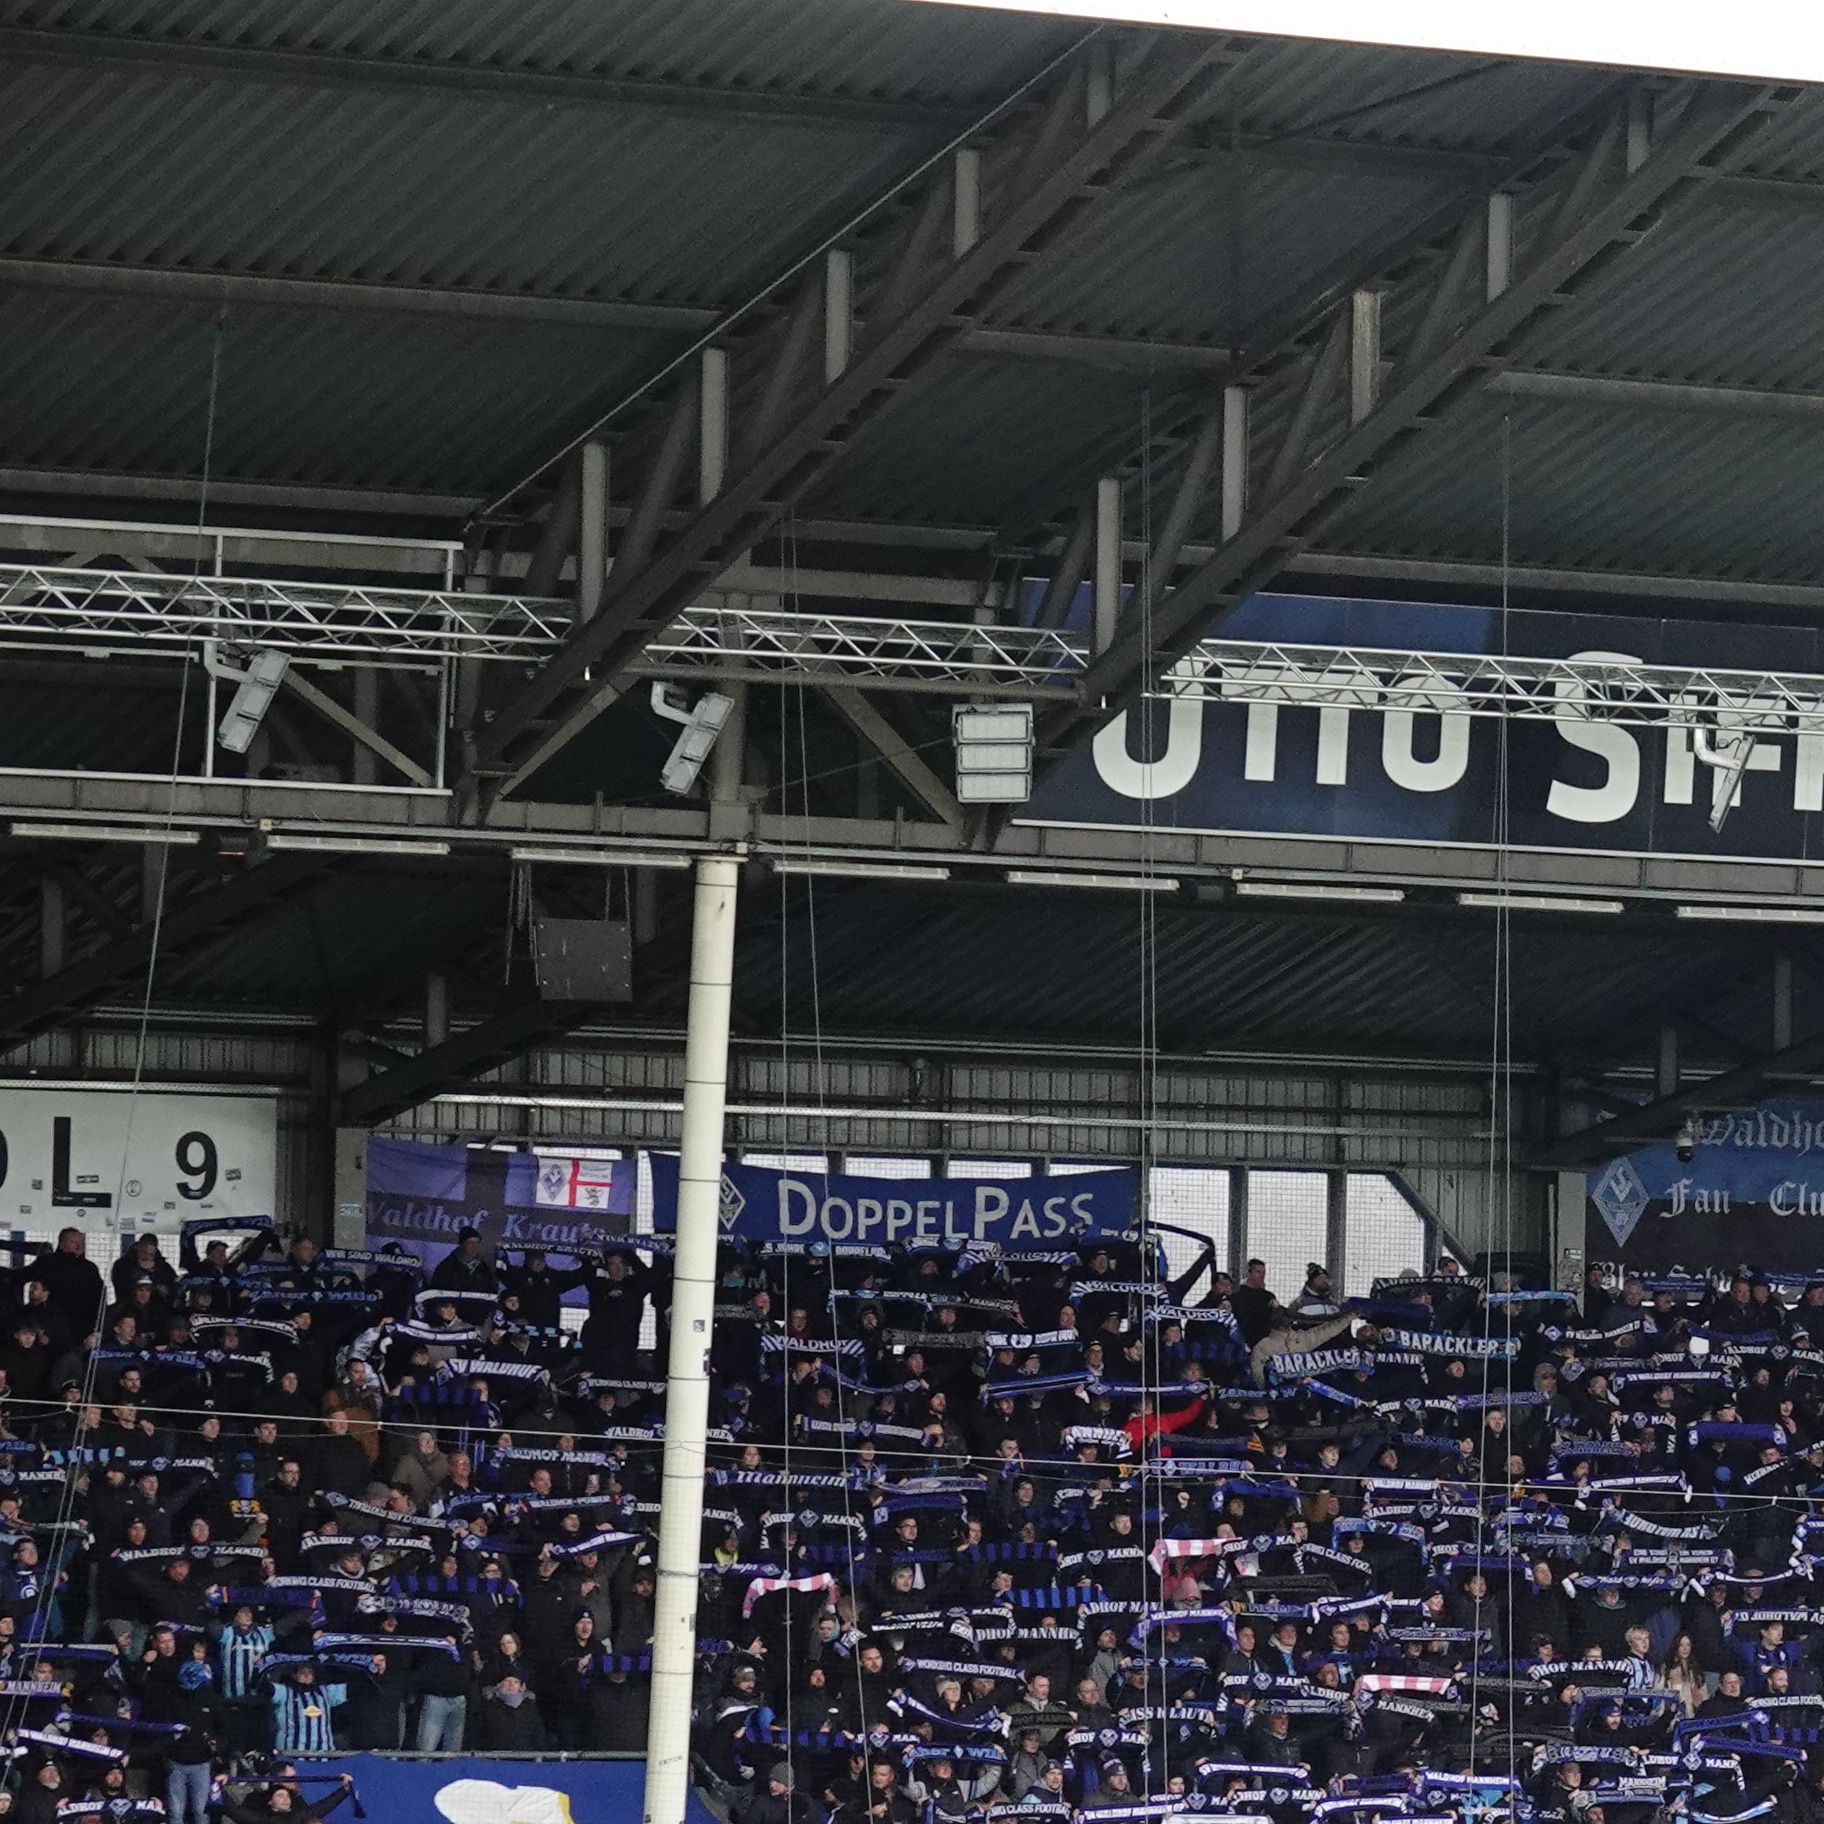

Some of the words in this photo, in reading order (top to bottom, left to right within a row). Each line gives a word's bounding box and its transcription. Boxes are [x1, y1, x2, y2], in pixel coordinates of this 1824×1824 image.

[175, 1131, 218, 1199] 9
[1659, 1177, 1731, 1218] Fan
[1401, 1330, 1499, 1356] BARACKLER
